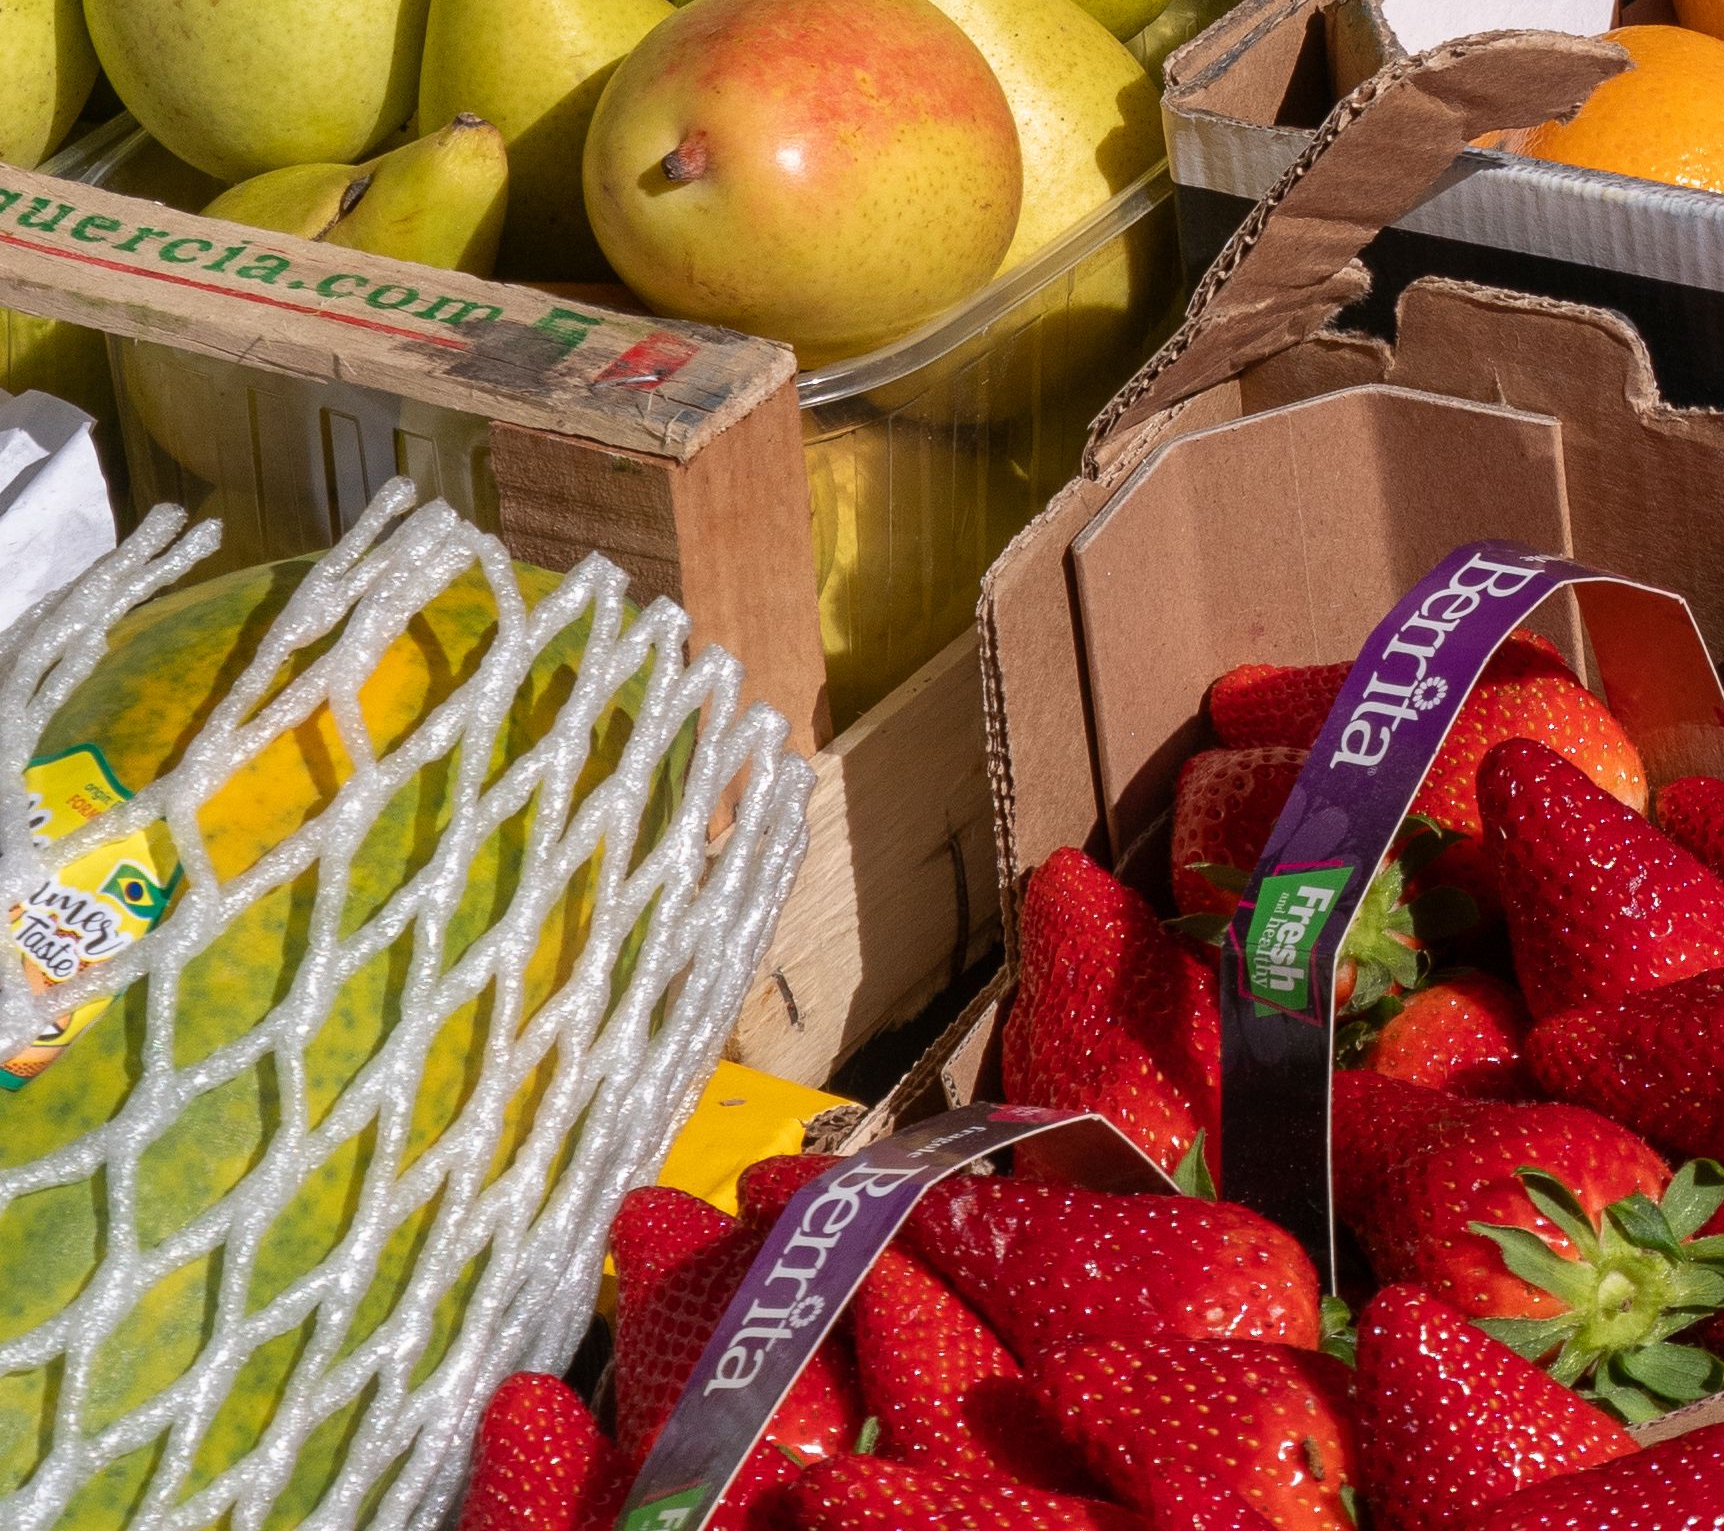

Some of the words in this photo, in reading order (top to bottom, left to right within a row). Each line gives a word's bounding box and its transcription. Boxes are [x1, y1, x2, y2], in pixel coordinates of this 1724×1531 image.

[1329, 551, 1546, 769] Berrita
[15, 913, 74, 978] Taste
[1253, 916, 1280, 989] healthy
[1269, 884, 1336, 992] Fresh
[703, 1162, 929, 1398] Berrita
